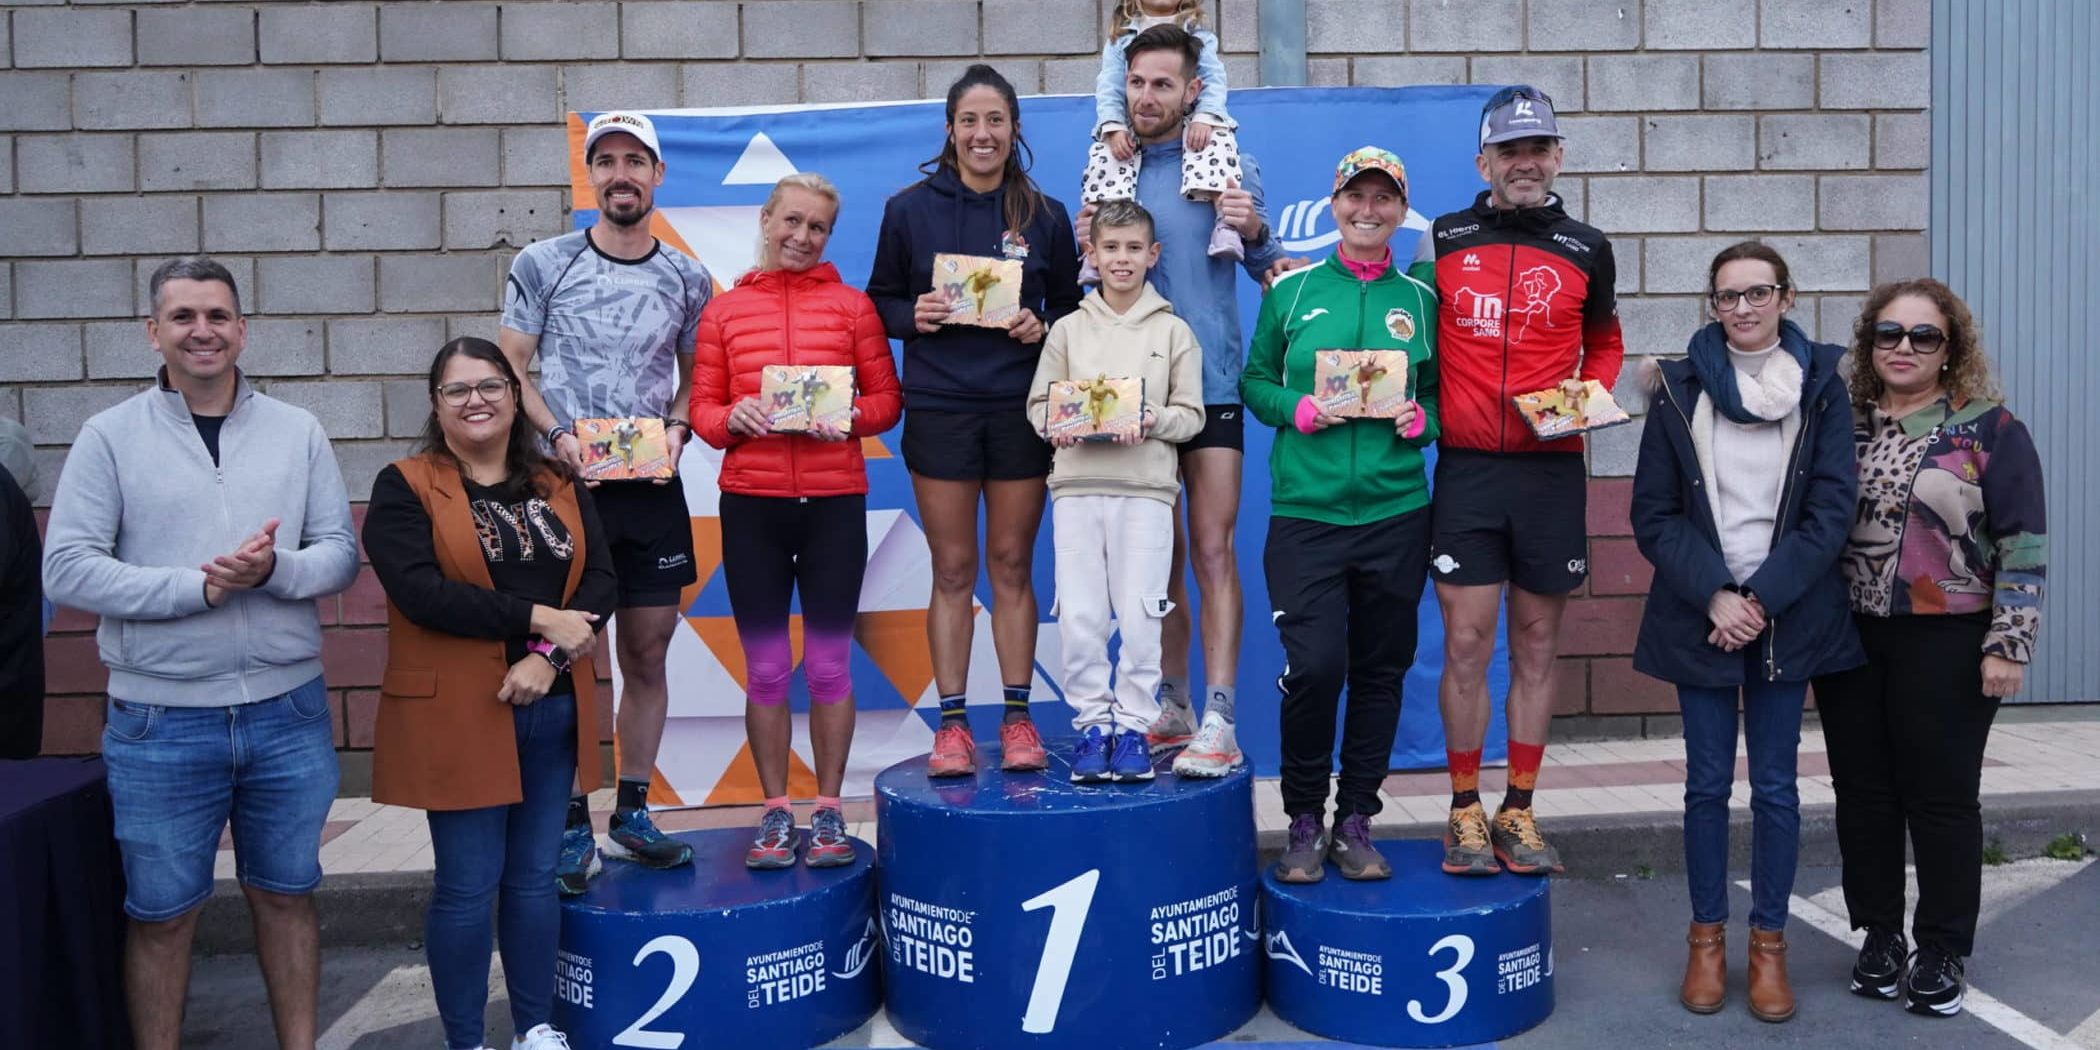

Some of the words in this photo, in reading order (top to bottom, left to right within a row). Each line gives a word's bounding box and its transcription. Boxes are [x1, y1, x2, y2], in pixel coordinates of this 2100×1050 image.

[1456, 317, 1501, 329] CORPORE
[1473, 328, 1500, 337] SANO
[891, 908, 973, 948] SANTIAGO
[1151, 902, 1239, 944] SANTIAGO
[746, 952, 825, 984] SANTIAGO
[893, 933, 901, 963] DEL
[901, 935, 974, 983] TEIDE
[1021, 869, 1100, 1034] 1
[1152, 947, 1166, 980] DEL
[1168, 925, 1241, 976] TEIDE
[1319, 953, 1382, 976] SANTIAGO
[1498, 952, 1541, 975] SANTIAGO
[612, 935, 700, 1050] 2
[748, 985, 760, 1009] DEL
[761, 968, 826, 1005] TEIDE
[1327, 968, 1382, 995] TEIDE
[1407, 934, 1475, 1024] 3
[1506, 964, 1541, 992] TEIDE
